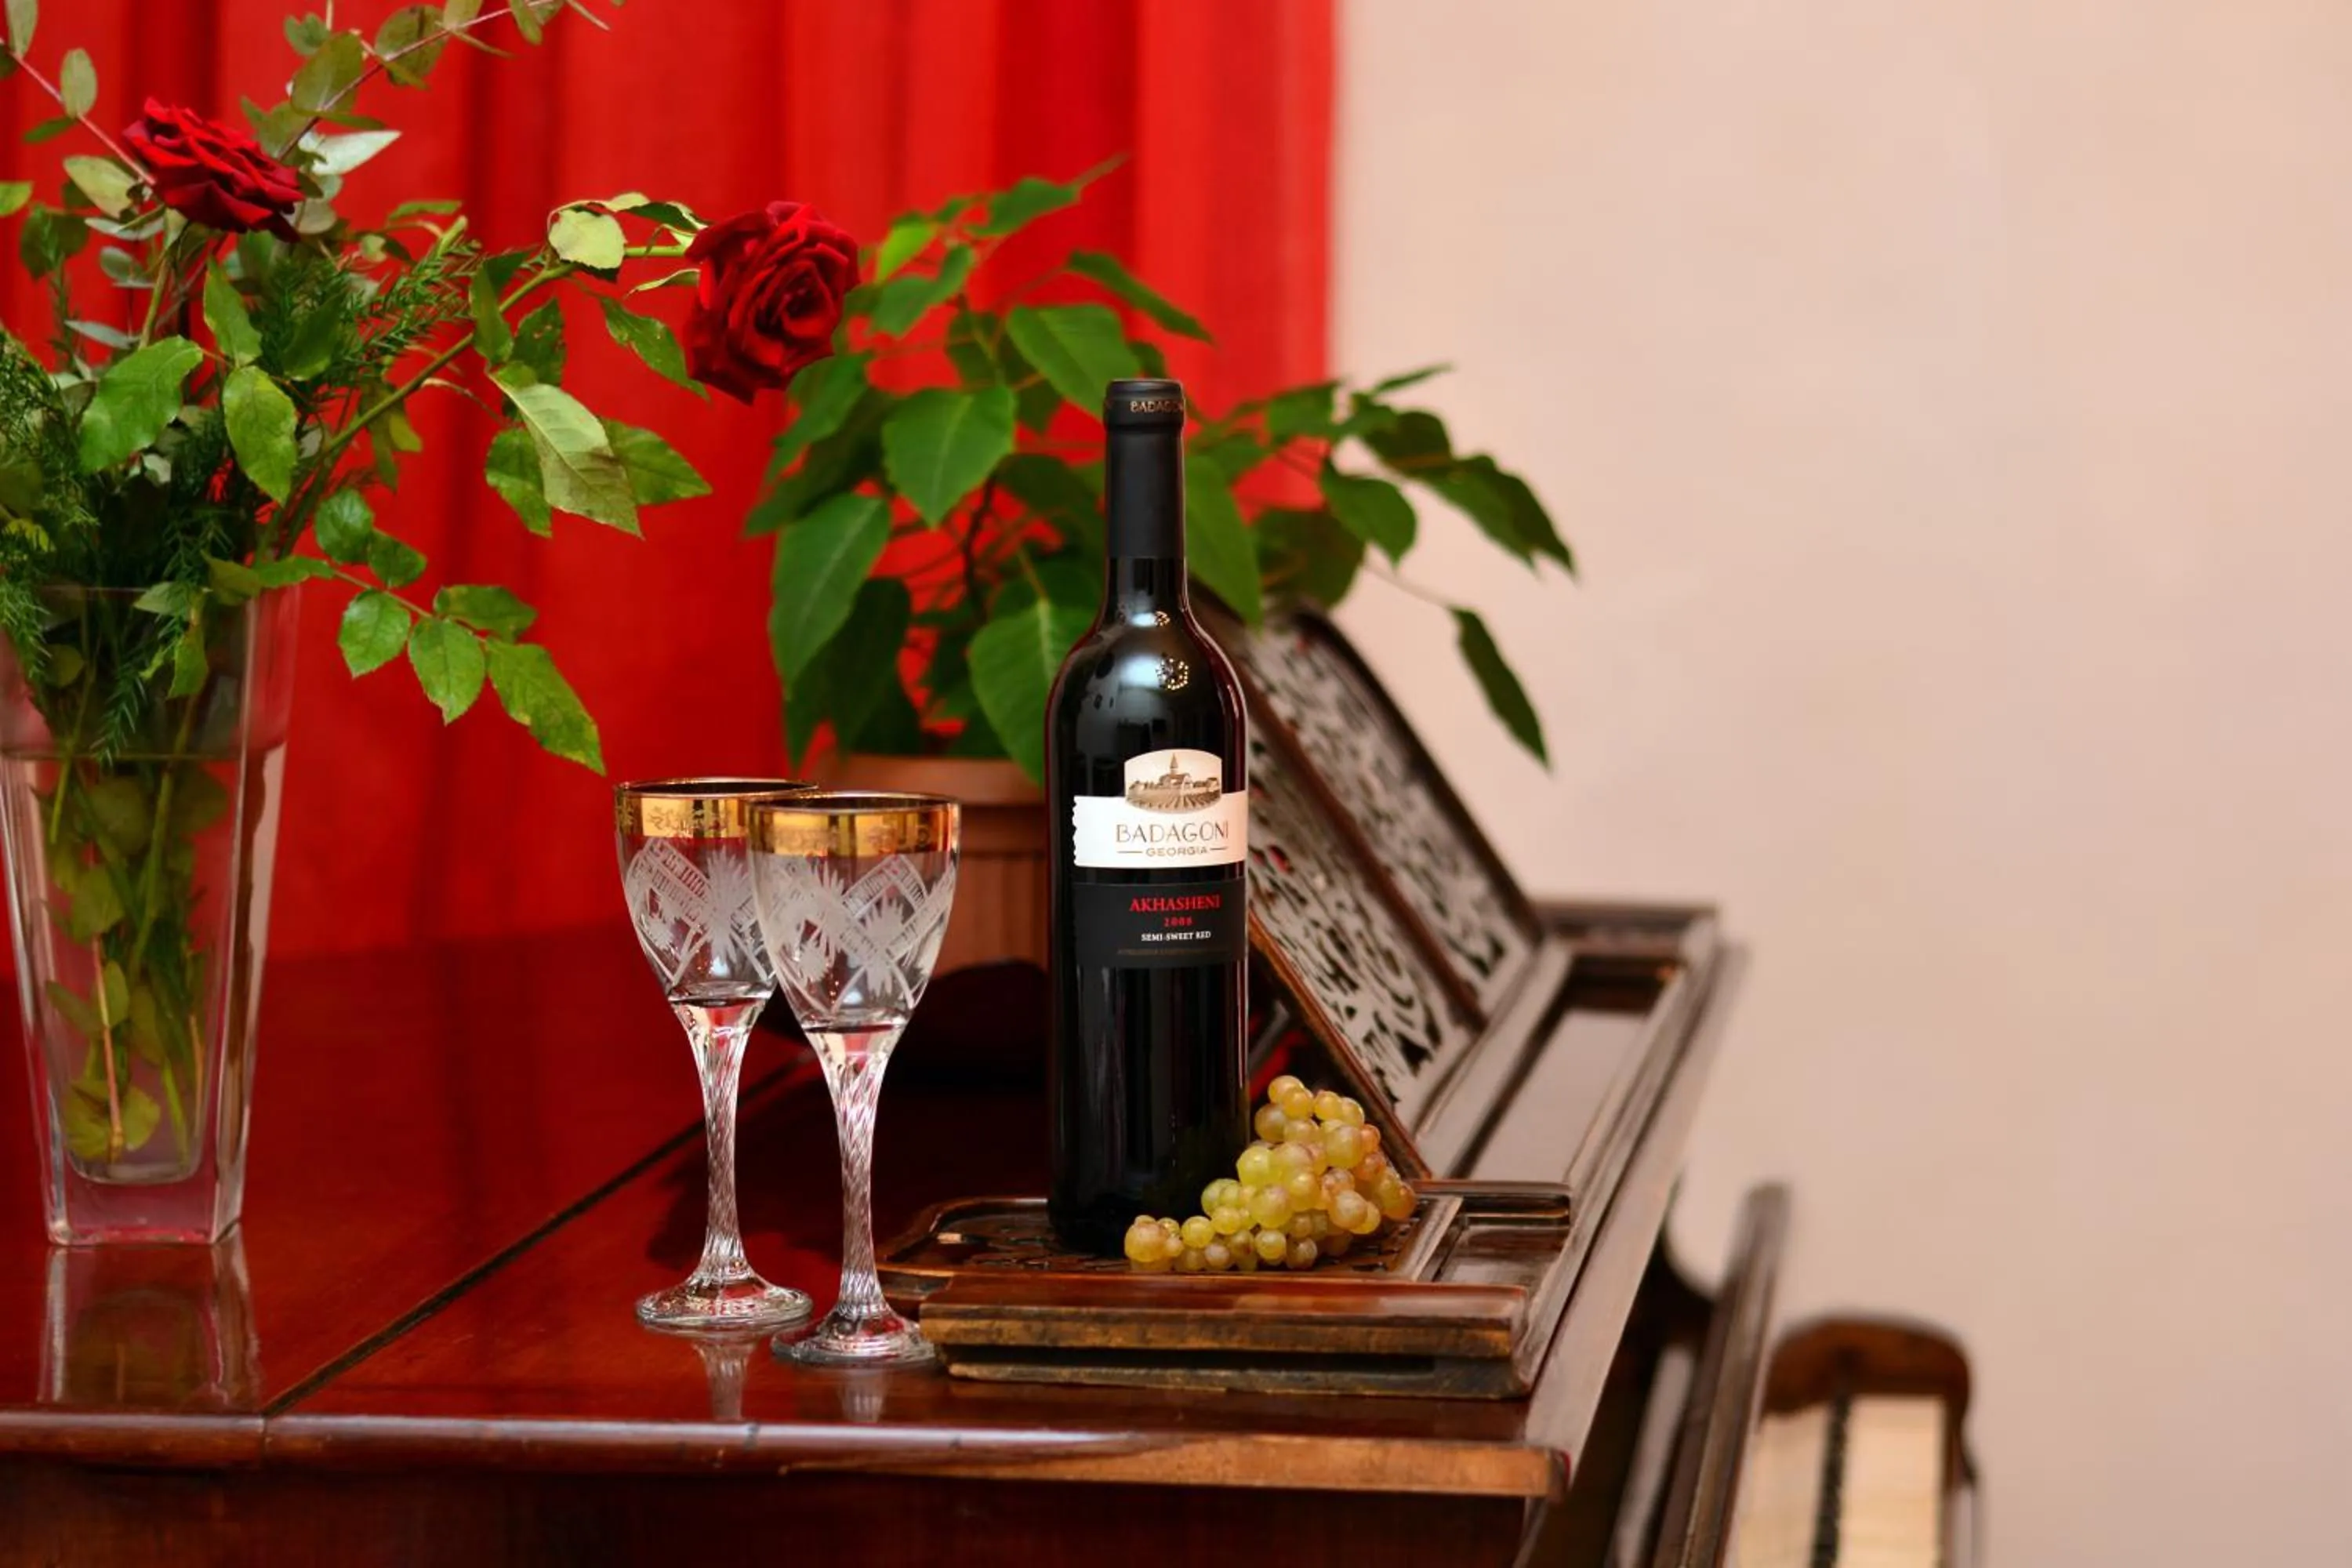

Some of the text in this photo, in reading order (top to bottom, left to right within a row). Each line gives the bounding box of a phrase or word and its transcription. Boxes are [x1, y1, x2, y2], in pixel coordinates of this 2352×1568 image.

[1116, 822, 1229, 843] BADAGONI
[1145, 846, 1208, 857] GEORGIA
[1129, 895, 1221, 912] AKHASHENI
[1196, 930, 1211, 940] RED
